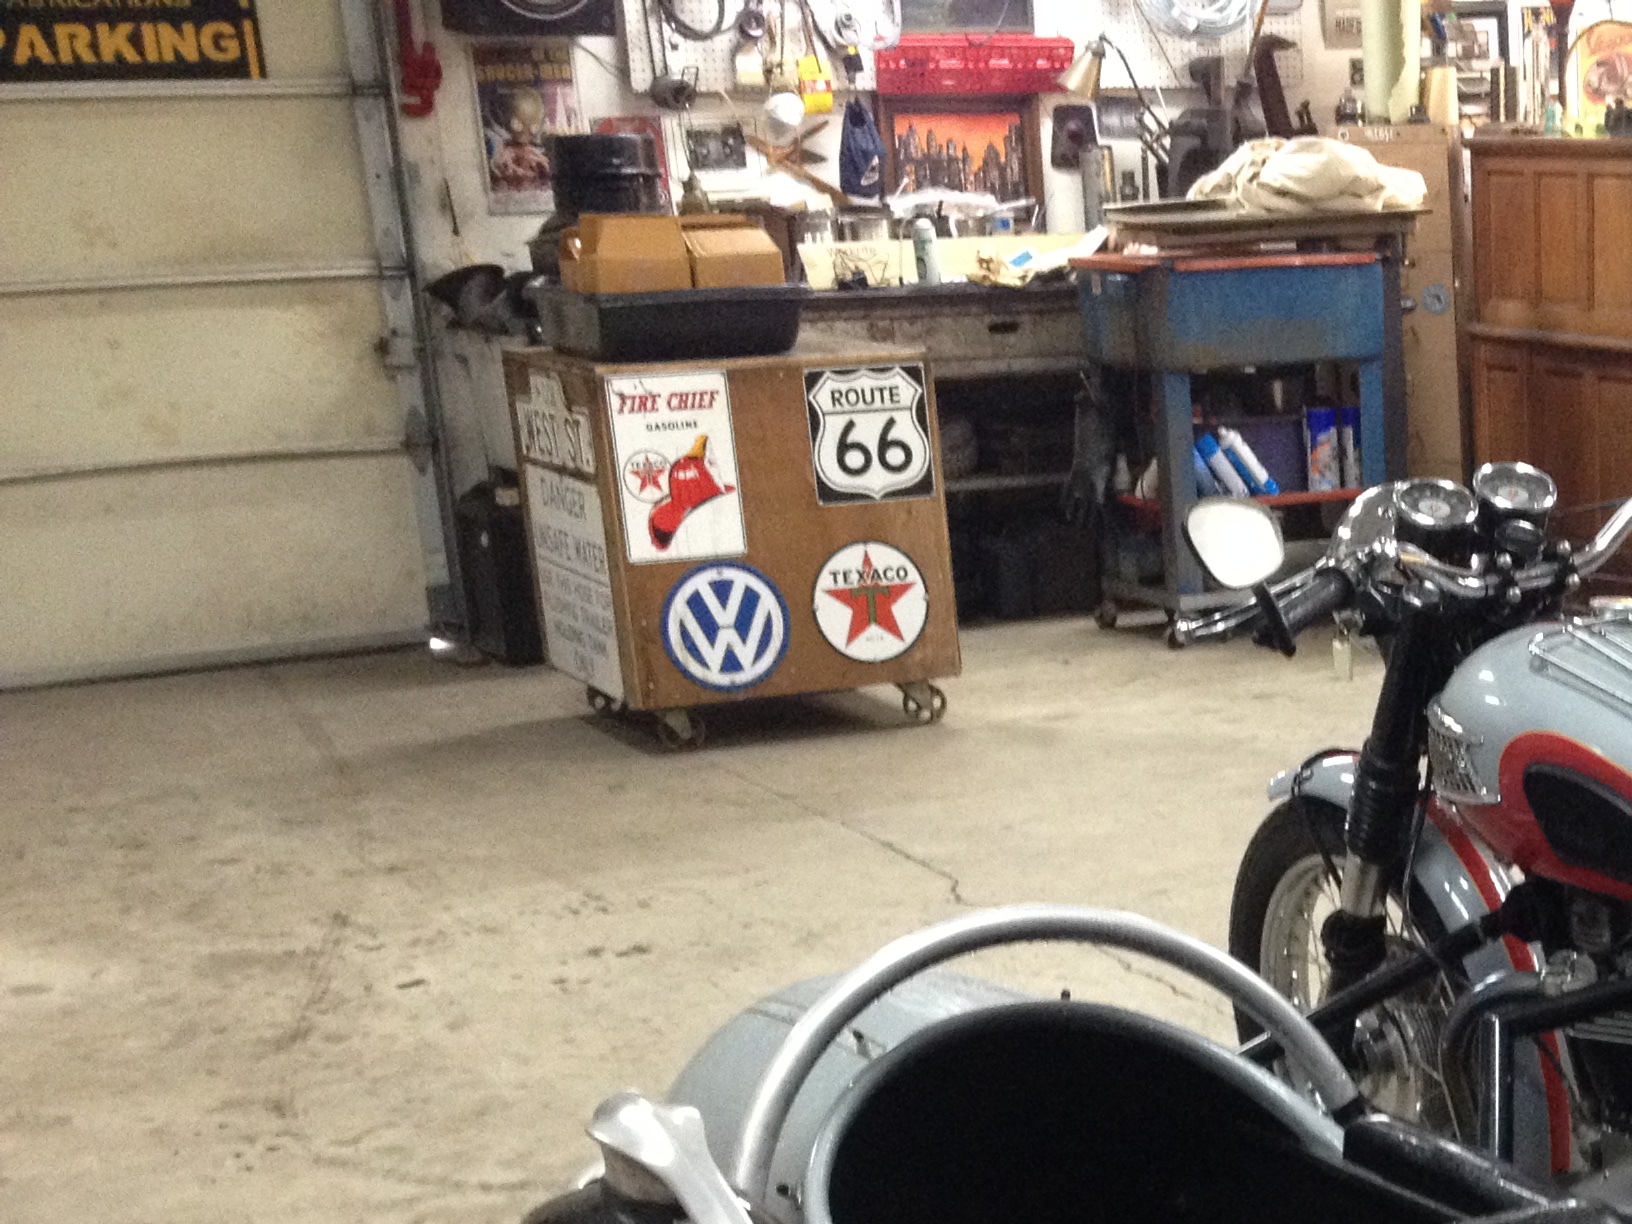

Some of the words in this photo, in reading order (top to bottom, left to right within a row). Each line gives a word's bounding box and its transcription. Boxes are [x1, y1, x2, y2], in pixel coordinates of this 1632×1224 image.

[0, 20, 240, 65] ARKING
[618, 392, 661, 414] FIRE
[666, 389, 719, 411] CHIEF
[830, 386, 901, 408] ROUTE
[645, 420, 699, 432] GASOLINE
[836, 416, 913, 476] 66
[829, 566, 908, 586] TEXACO
